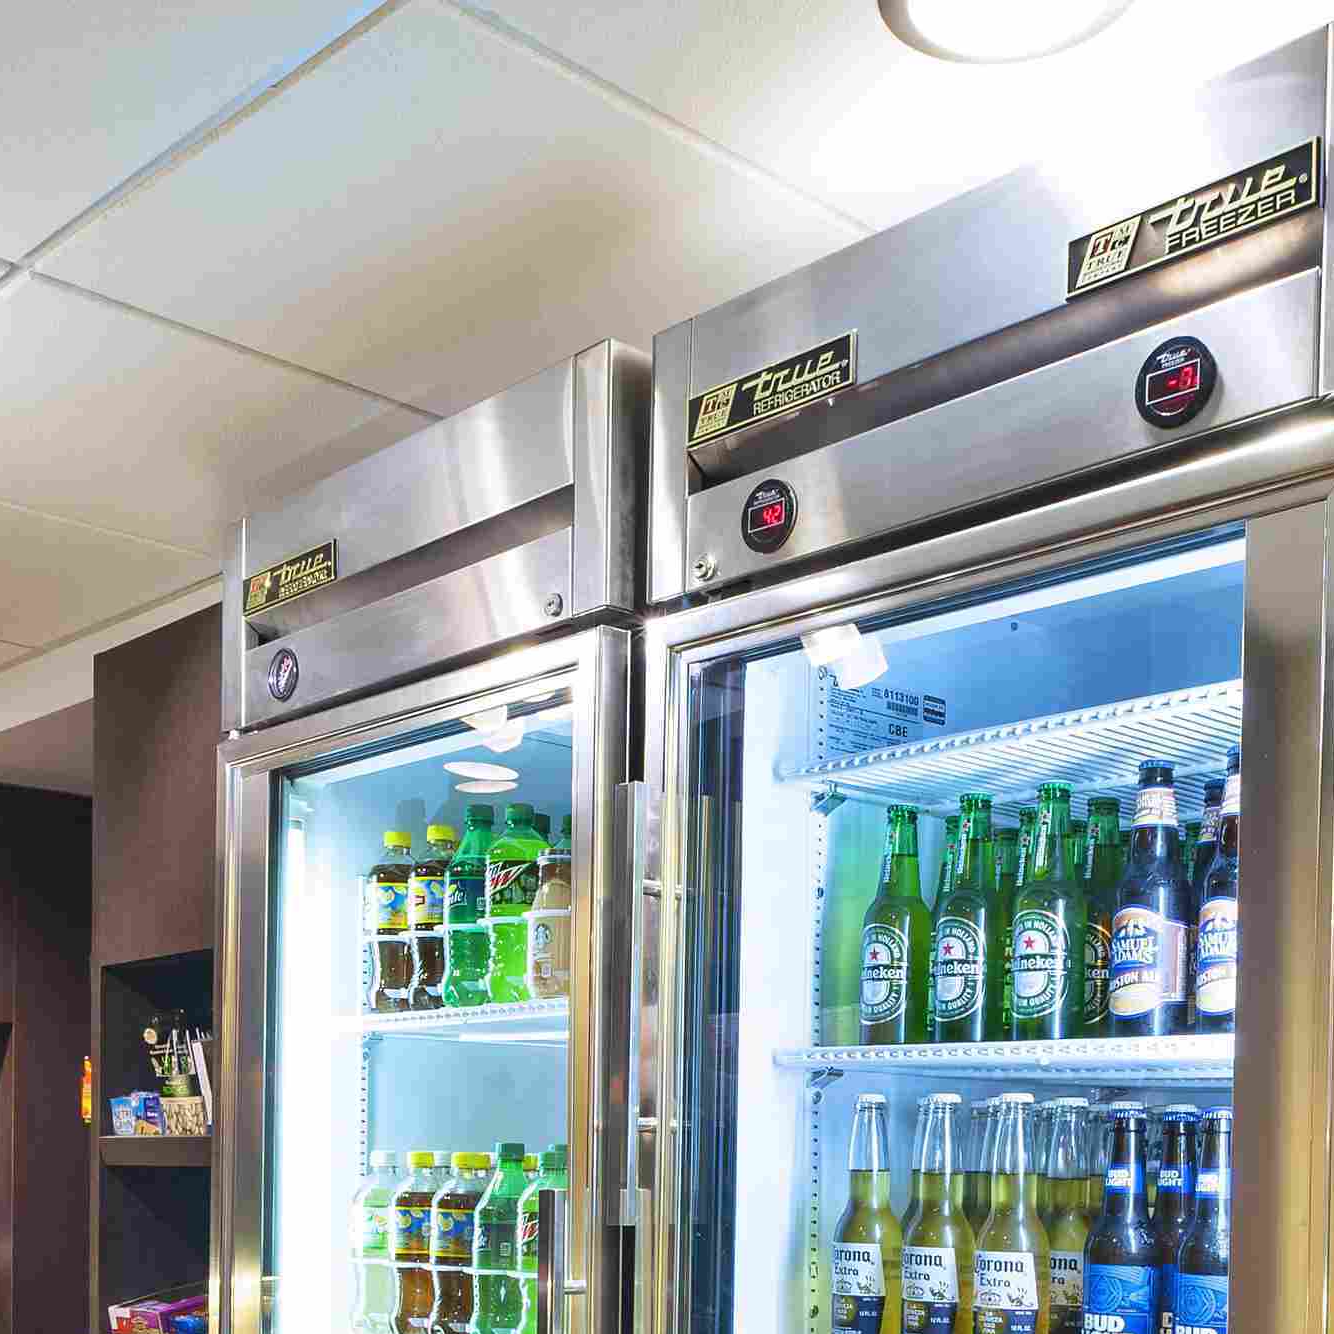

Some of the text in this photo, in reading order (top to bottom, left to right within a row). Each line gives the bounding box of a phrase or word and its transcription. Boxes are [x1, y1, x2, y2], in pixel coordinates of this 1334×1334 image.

[1165, 189, 1296, 254] FREEZER
[753, 370, 842, 416] REFRIGERATOR
[979, 1273, 1011, 1288] Extra
[1083, 1313, 1126, 1332] BUD
